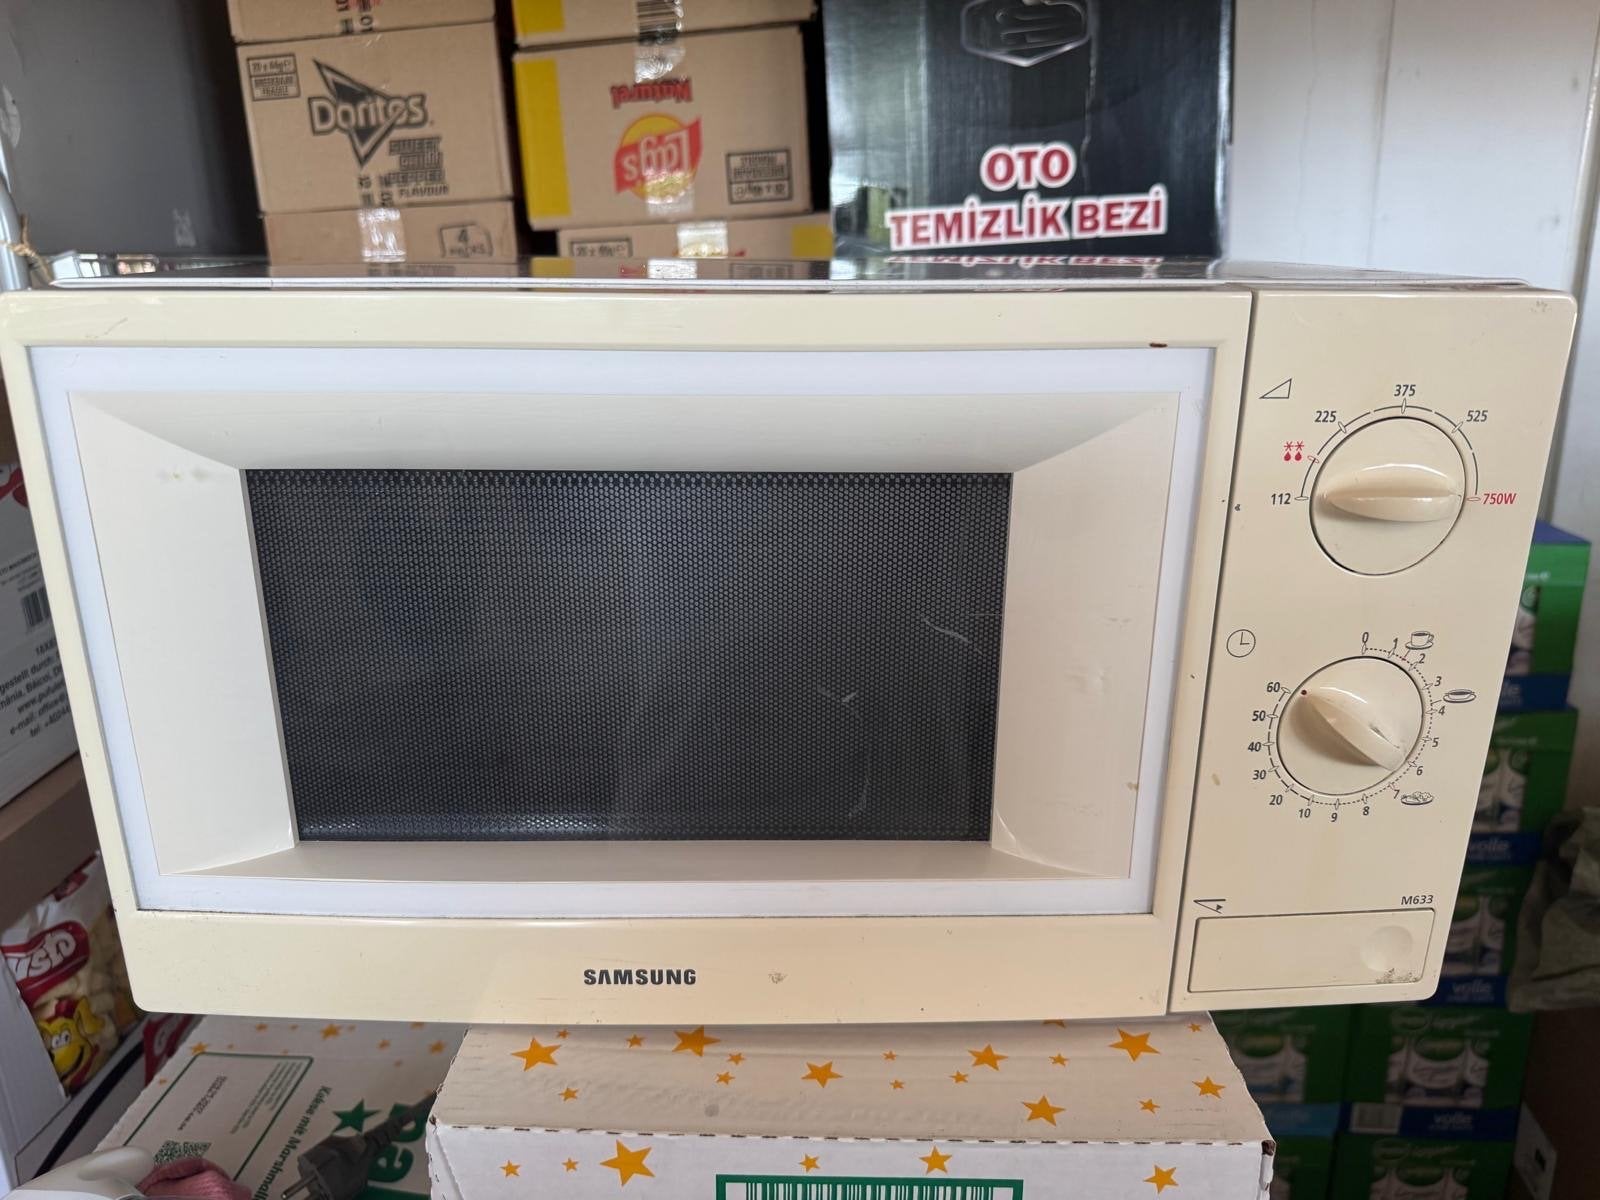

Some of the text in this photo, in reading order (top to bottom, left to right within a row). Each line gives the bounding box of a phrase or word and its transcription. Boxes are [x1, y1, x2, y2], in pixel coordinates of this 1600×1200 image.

[308, 93, 427, 136] Doritos
[983, 145, 1073, 189] OTO
[887, 186, 1165, 249] TEMİZLİK BEZİ
[1394, 384, 1416, 397] 375
[1314, 410, 1337, 423] 225
[1466, 410, 1488, 422] 525
[1270, 493, 1292, 505] 112
[1482, 493, 1517, 505] 750W
[1362, 632, 1370, 644] 0
[1392, 638, 1398, 648] 1
[1418, 653, 1426, 664] 2
[1434, 676, 1442, 687] 3
[1266, 682, 1280, 693] 60
[1252, 711, 1266, 722] 50
[1438, 706, 1446, 716] 4
[1248, 742, 1262, 752] 40
[1432, 738, 1439, 748] 5
[1252, 770, 1267, 780] 30
[1416, 766, 1424, 776] 6
[1394, 789, 1400, 800] 7
[1269, 795, 1283, 806] 20
[1298, 808, 1311, 818] 10
[1362, 806, 1370, 816] 8
[1331, 812, 1338, 822] 9
[1401, 895, 1434, 906] M633
[583, 968, 697, 986] SAMSUNG
